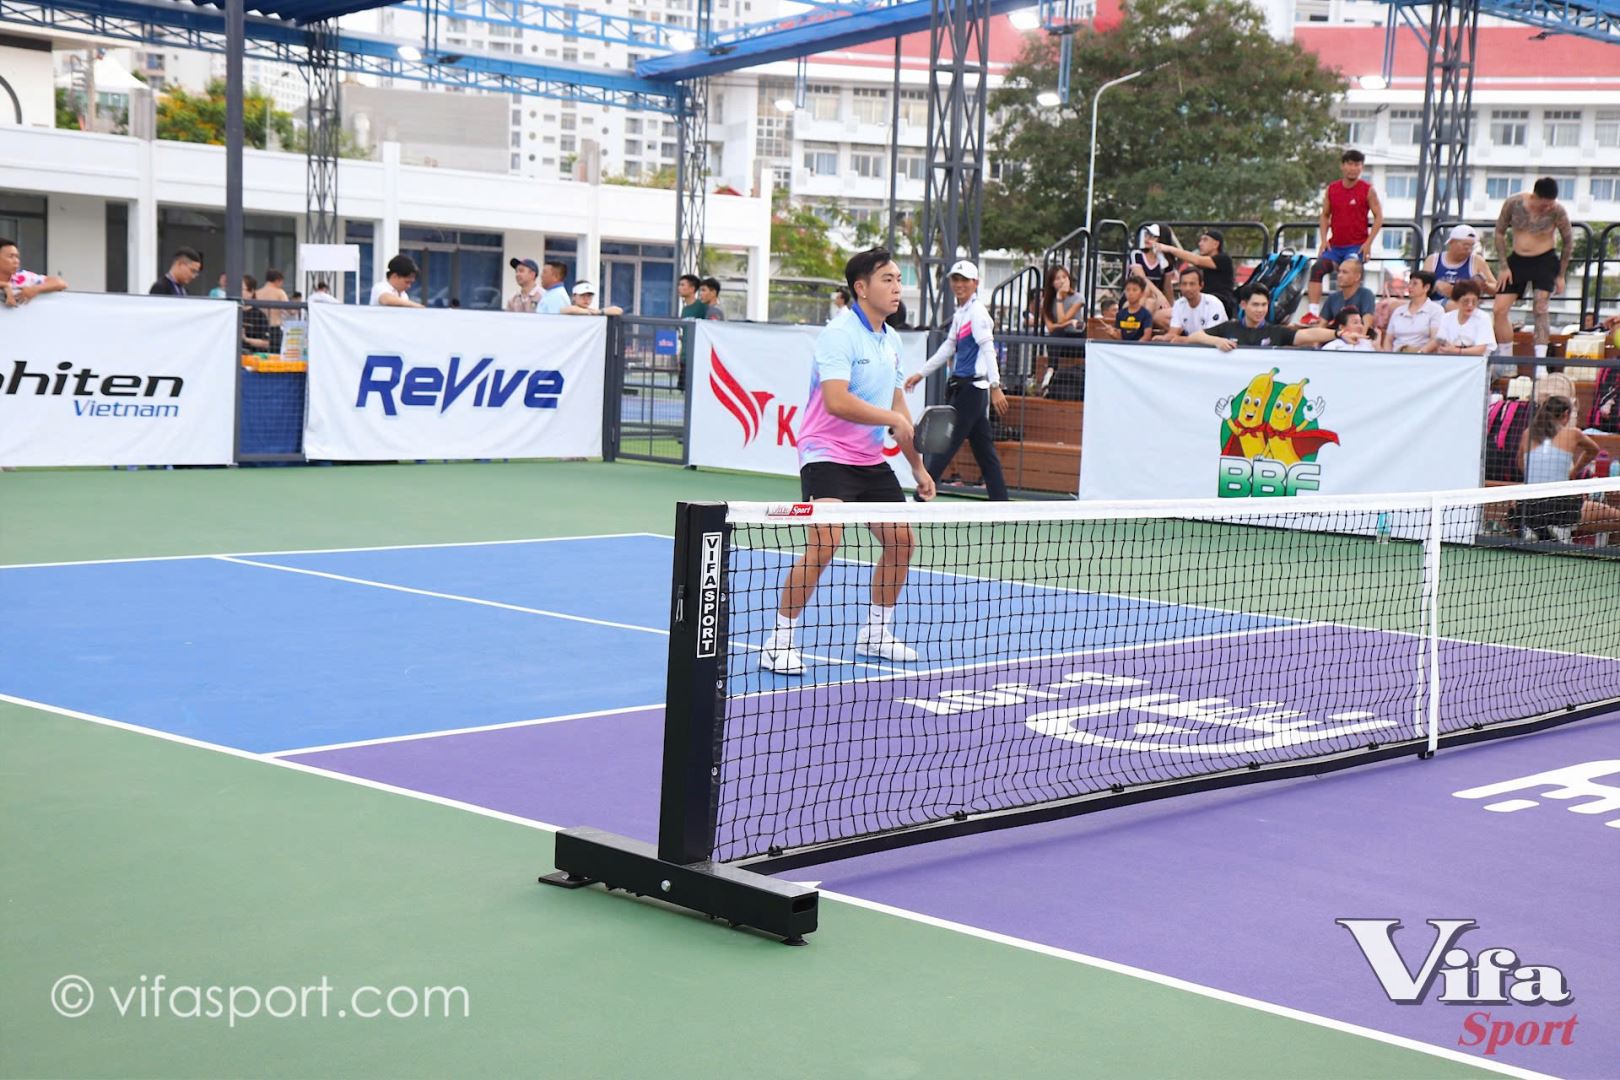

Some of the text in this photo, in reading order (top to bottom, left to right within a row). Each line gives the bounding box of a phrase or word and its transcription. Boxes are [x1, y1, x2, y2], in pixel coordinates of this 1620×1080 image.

[0, 361, 184, 398] hiten
[355, 355, 565, 416] ReVive
[73, 400, 179, 418] Vietnam
[1218, 457, 1321, 497] BBF
[792, 504, 812, 516] Sport
